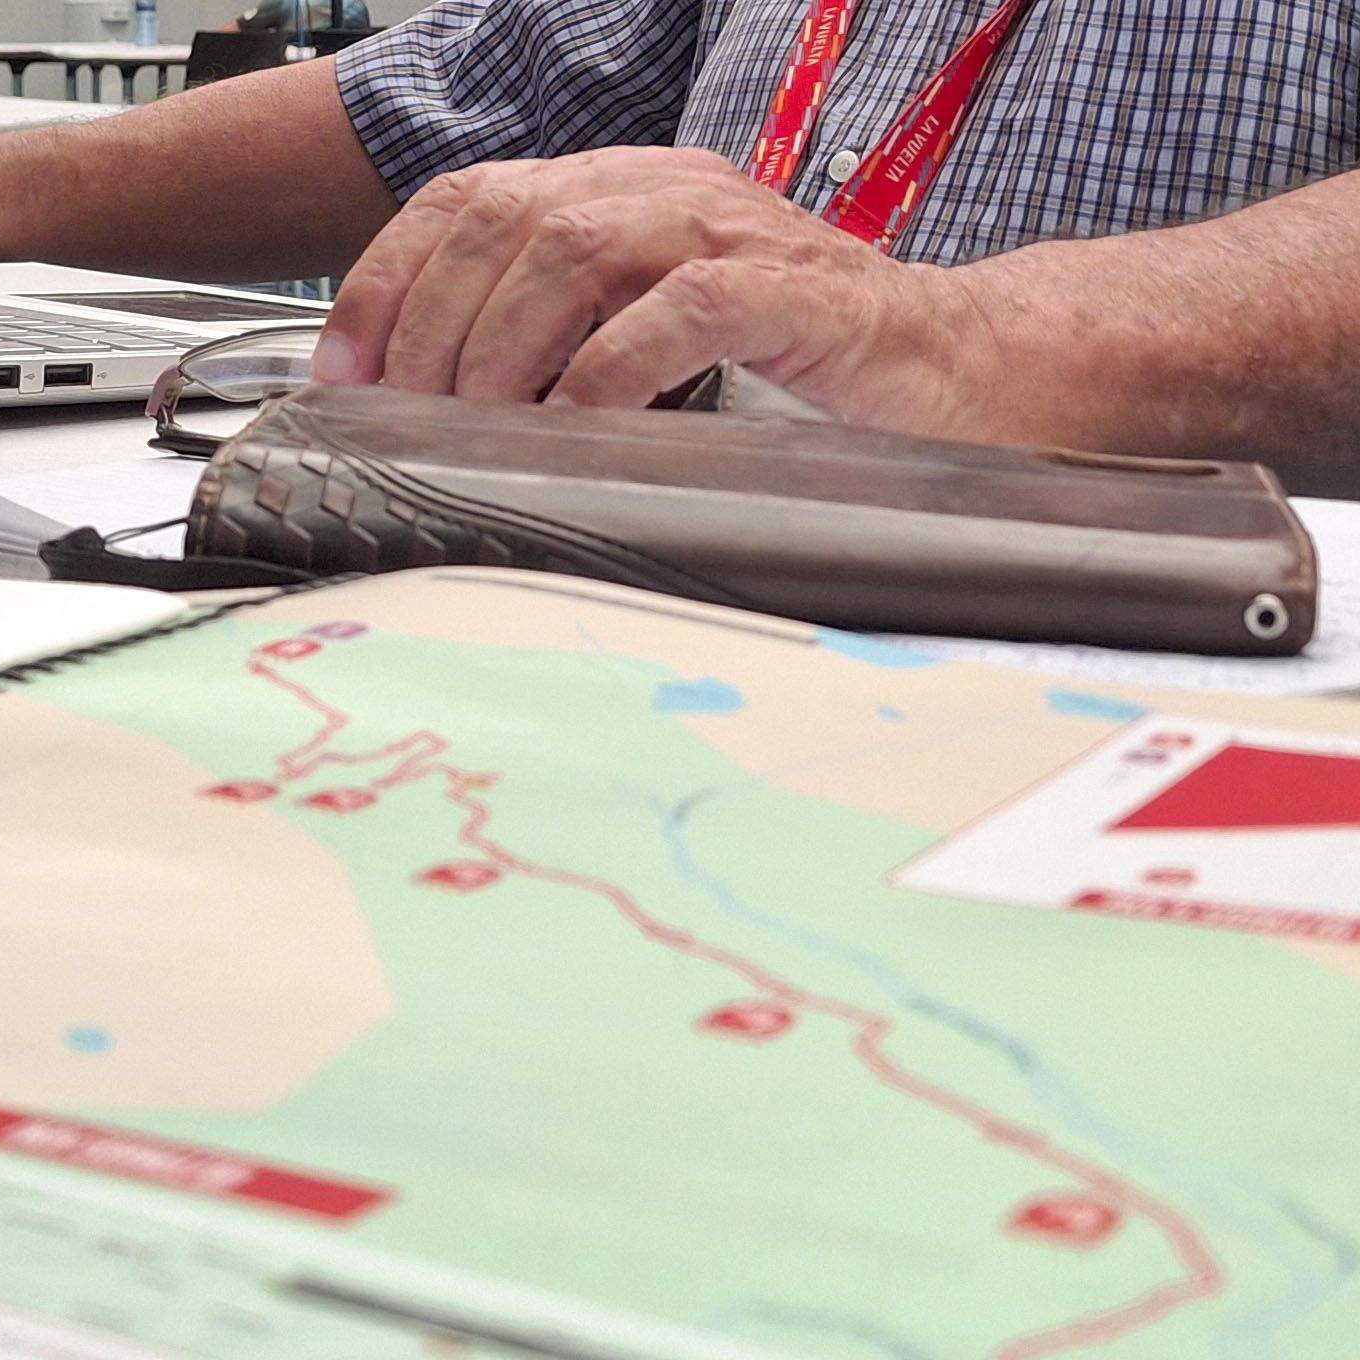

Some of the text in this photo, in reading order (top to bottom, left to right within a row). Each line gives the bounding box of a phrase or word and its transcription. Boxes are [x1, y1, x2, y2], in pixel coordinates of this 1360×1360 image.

[804, 6, 839, 68] LA VUELTA
[758, 136, 789, 188] LA VUEL
[884, 114, 940, 183] LA VUELTA
